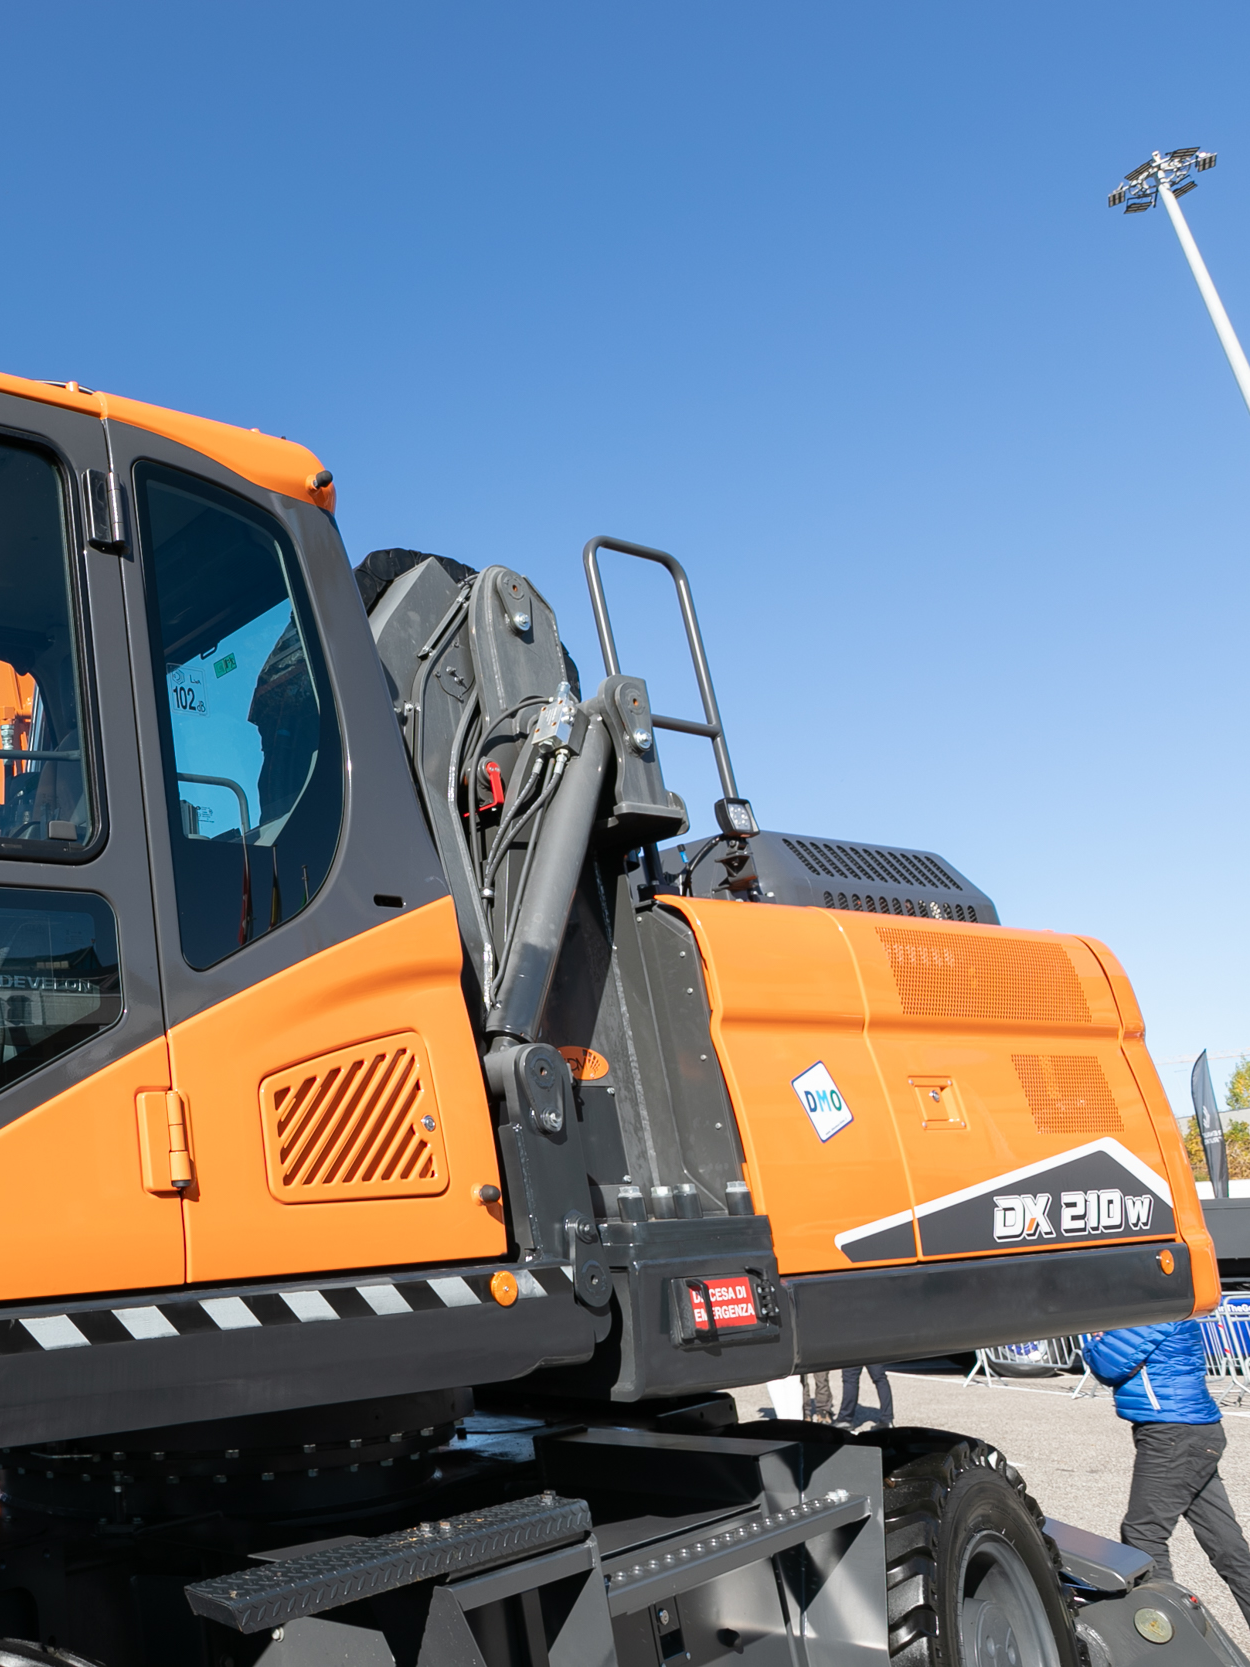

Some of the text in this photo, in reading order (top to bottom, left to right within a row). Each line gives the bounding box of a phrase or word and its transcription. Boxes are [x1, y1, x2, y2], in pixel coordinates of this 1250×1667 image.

[173, 686, 196, 711] 102
[804, 1089, 842, 1112] DMO
[993, 1193, 1056, 1243] DX
[692, 1285, 747, 1304] DICESA DI
